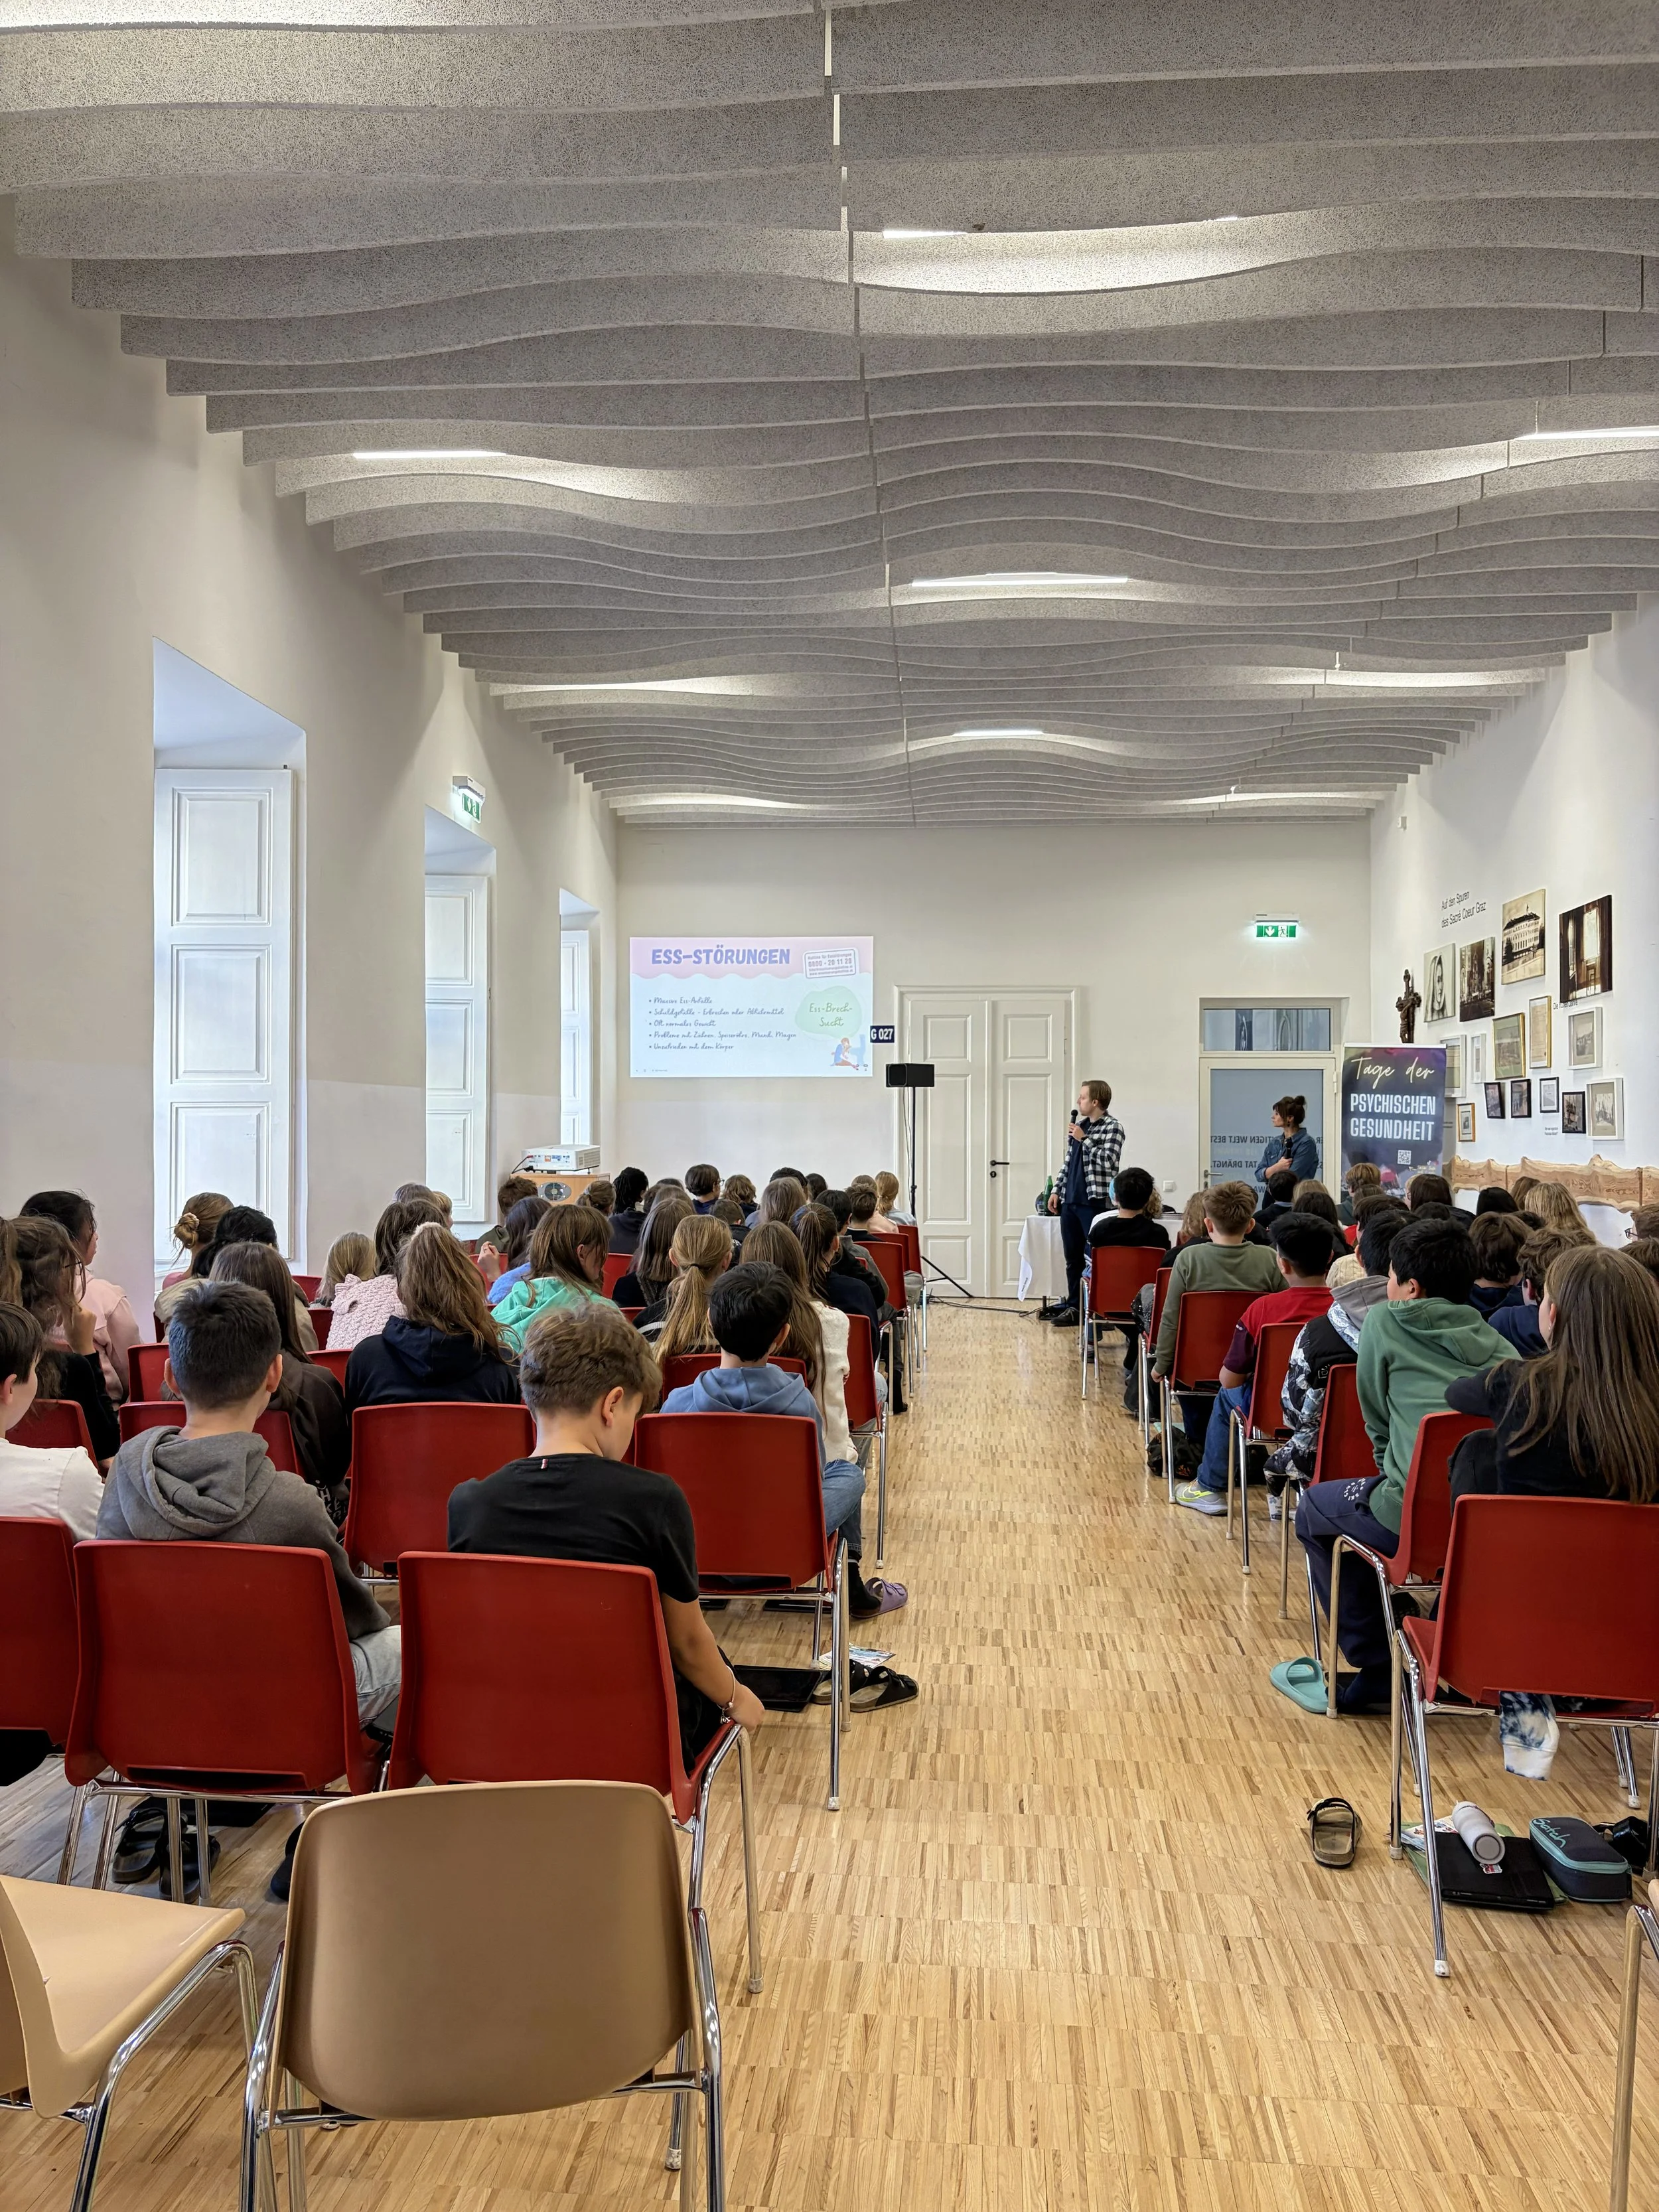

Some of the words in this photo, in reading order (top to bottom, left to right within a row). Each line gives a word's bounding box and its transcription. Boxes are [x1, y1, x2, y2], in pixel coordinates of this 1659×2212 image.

[1457, 891, 1469, 905] Spuren
[1476, 902, 1486, 913] Graz
[652, 944, 790, 964] ESS-STÖRUNGEN
[810, 1002, 853, 1012] Ess-Brech-
[819, 1017, 844, 1027] Sucht
[871, 1028, 877, 1040] G
[879, 1028, 893, 1040] 027
[1351, 1057, 1395, 1089] Tage
[1406, 1057, 1435, 1083] der
[1350, 1093, 1436, 1115] PSYCHISCHEN
[1350, 1118, 1435, 1141] GESUNDHEIT
